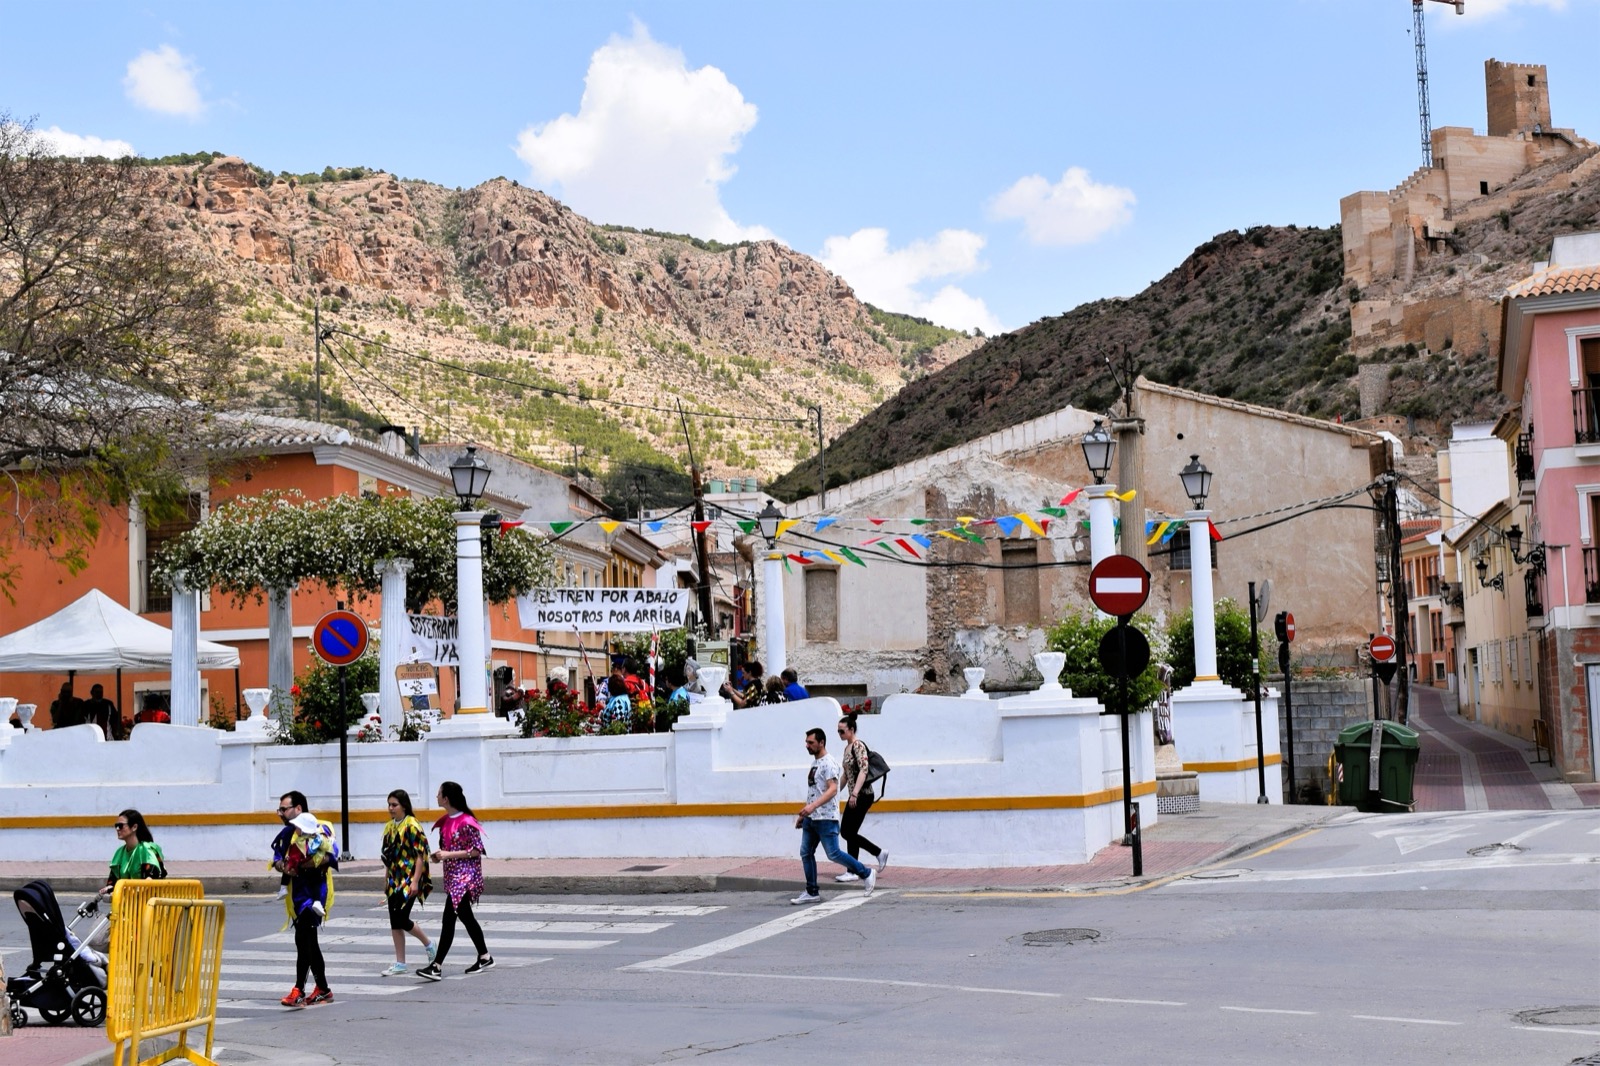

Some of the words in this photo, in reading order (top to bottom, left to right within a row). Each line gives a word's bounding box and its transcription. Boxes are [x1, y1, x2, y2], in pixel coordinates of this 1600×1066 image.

[557, 589, 594, 603] TREN
[601, 590, 628, 603] POR
[634, 590, 678, 604] ABAJO
[538, 610, 603, 623] NOSOTROS
[609, 609, 630, 623] POR
[409, 616, 459, 640] SOTERRAMI
